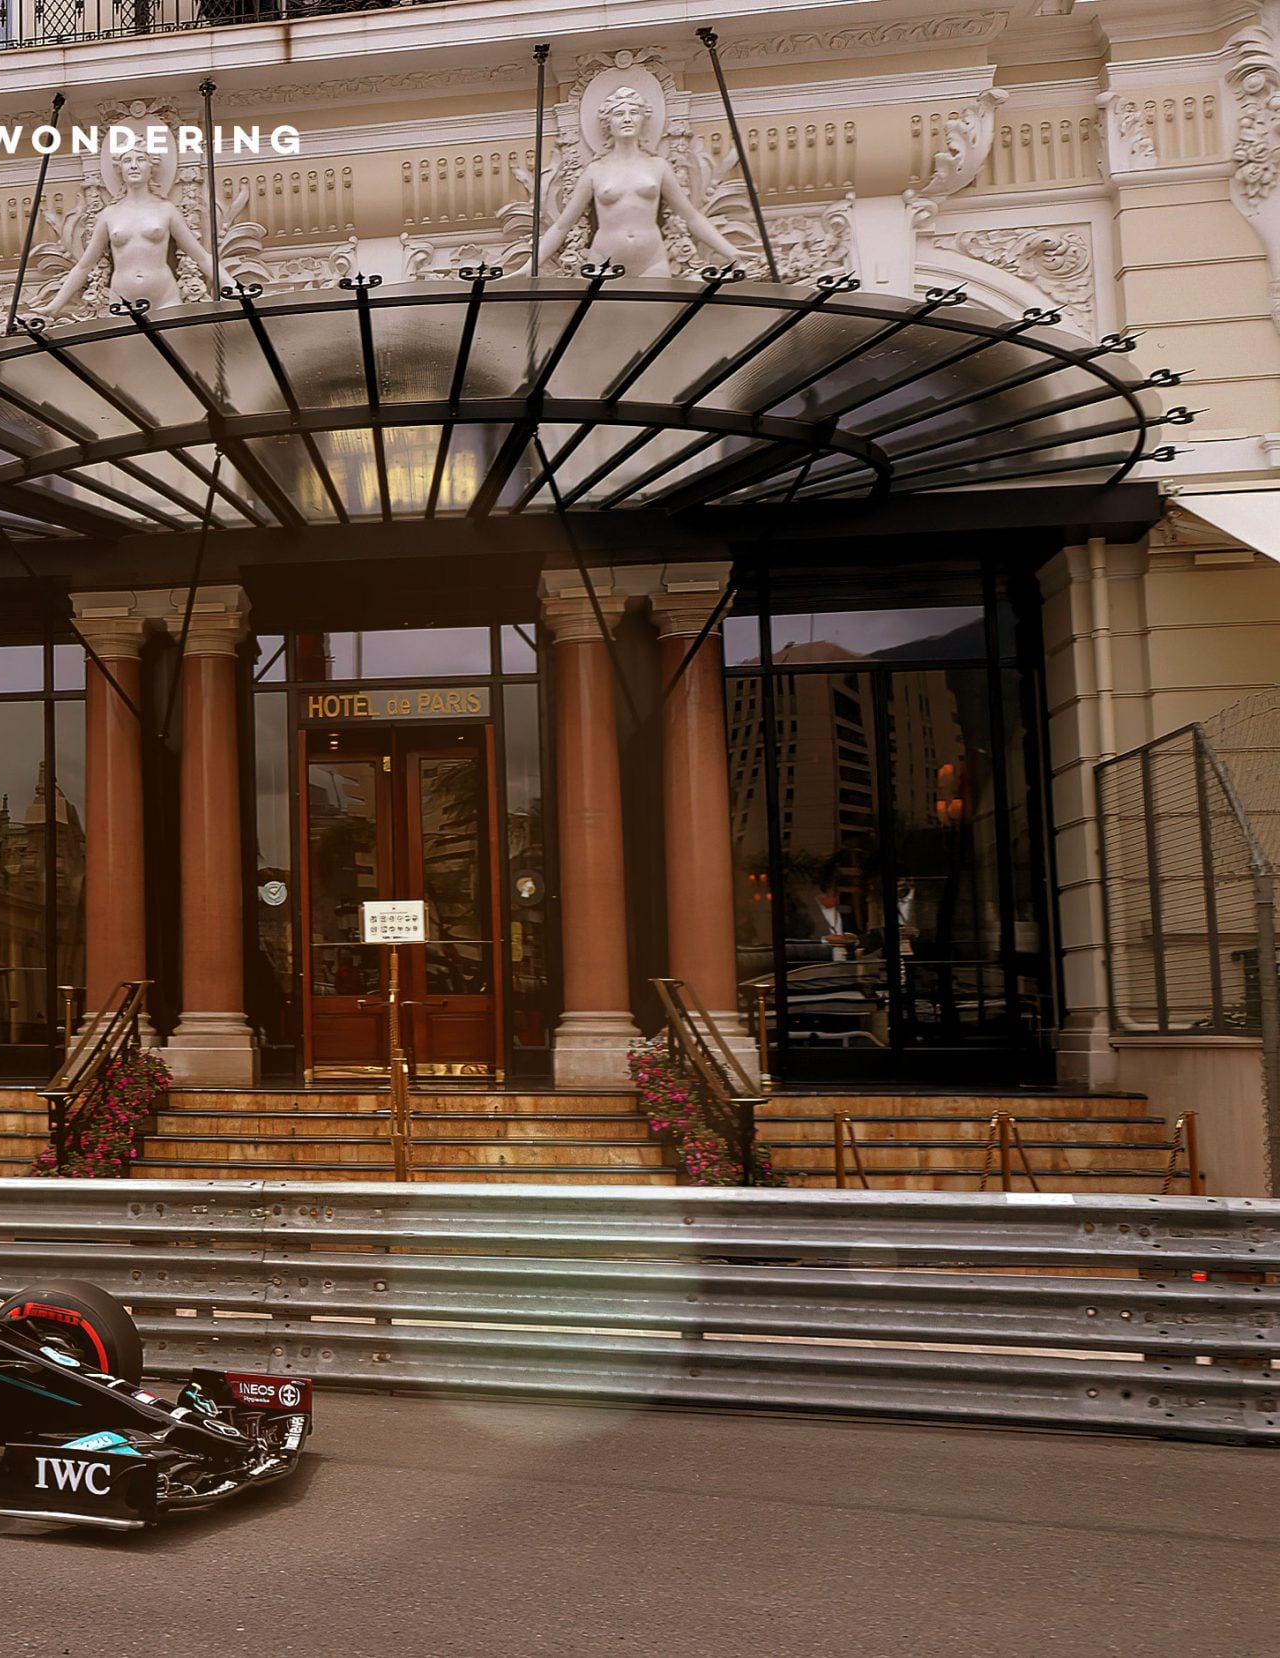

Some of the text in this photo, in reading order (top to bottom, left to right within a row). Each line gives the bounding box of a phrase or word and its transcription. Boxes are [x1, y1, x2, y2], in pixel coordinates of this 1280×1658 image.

[308, 691, 482, 718] HOTEL de PARIS
[239, 1382, 276, 1396] INEOS
[34, 1457, 111, 1495] IWC
